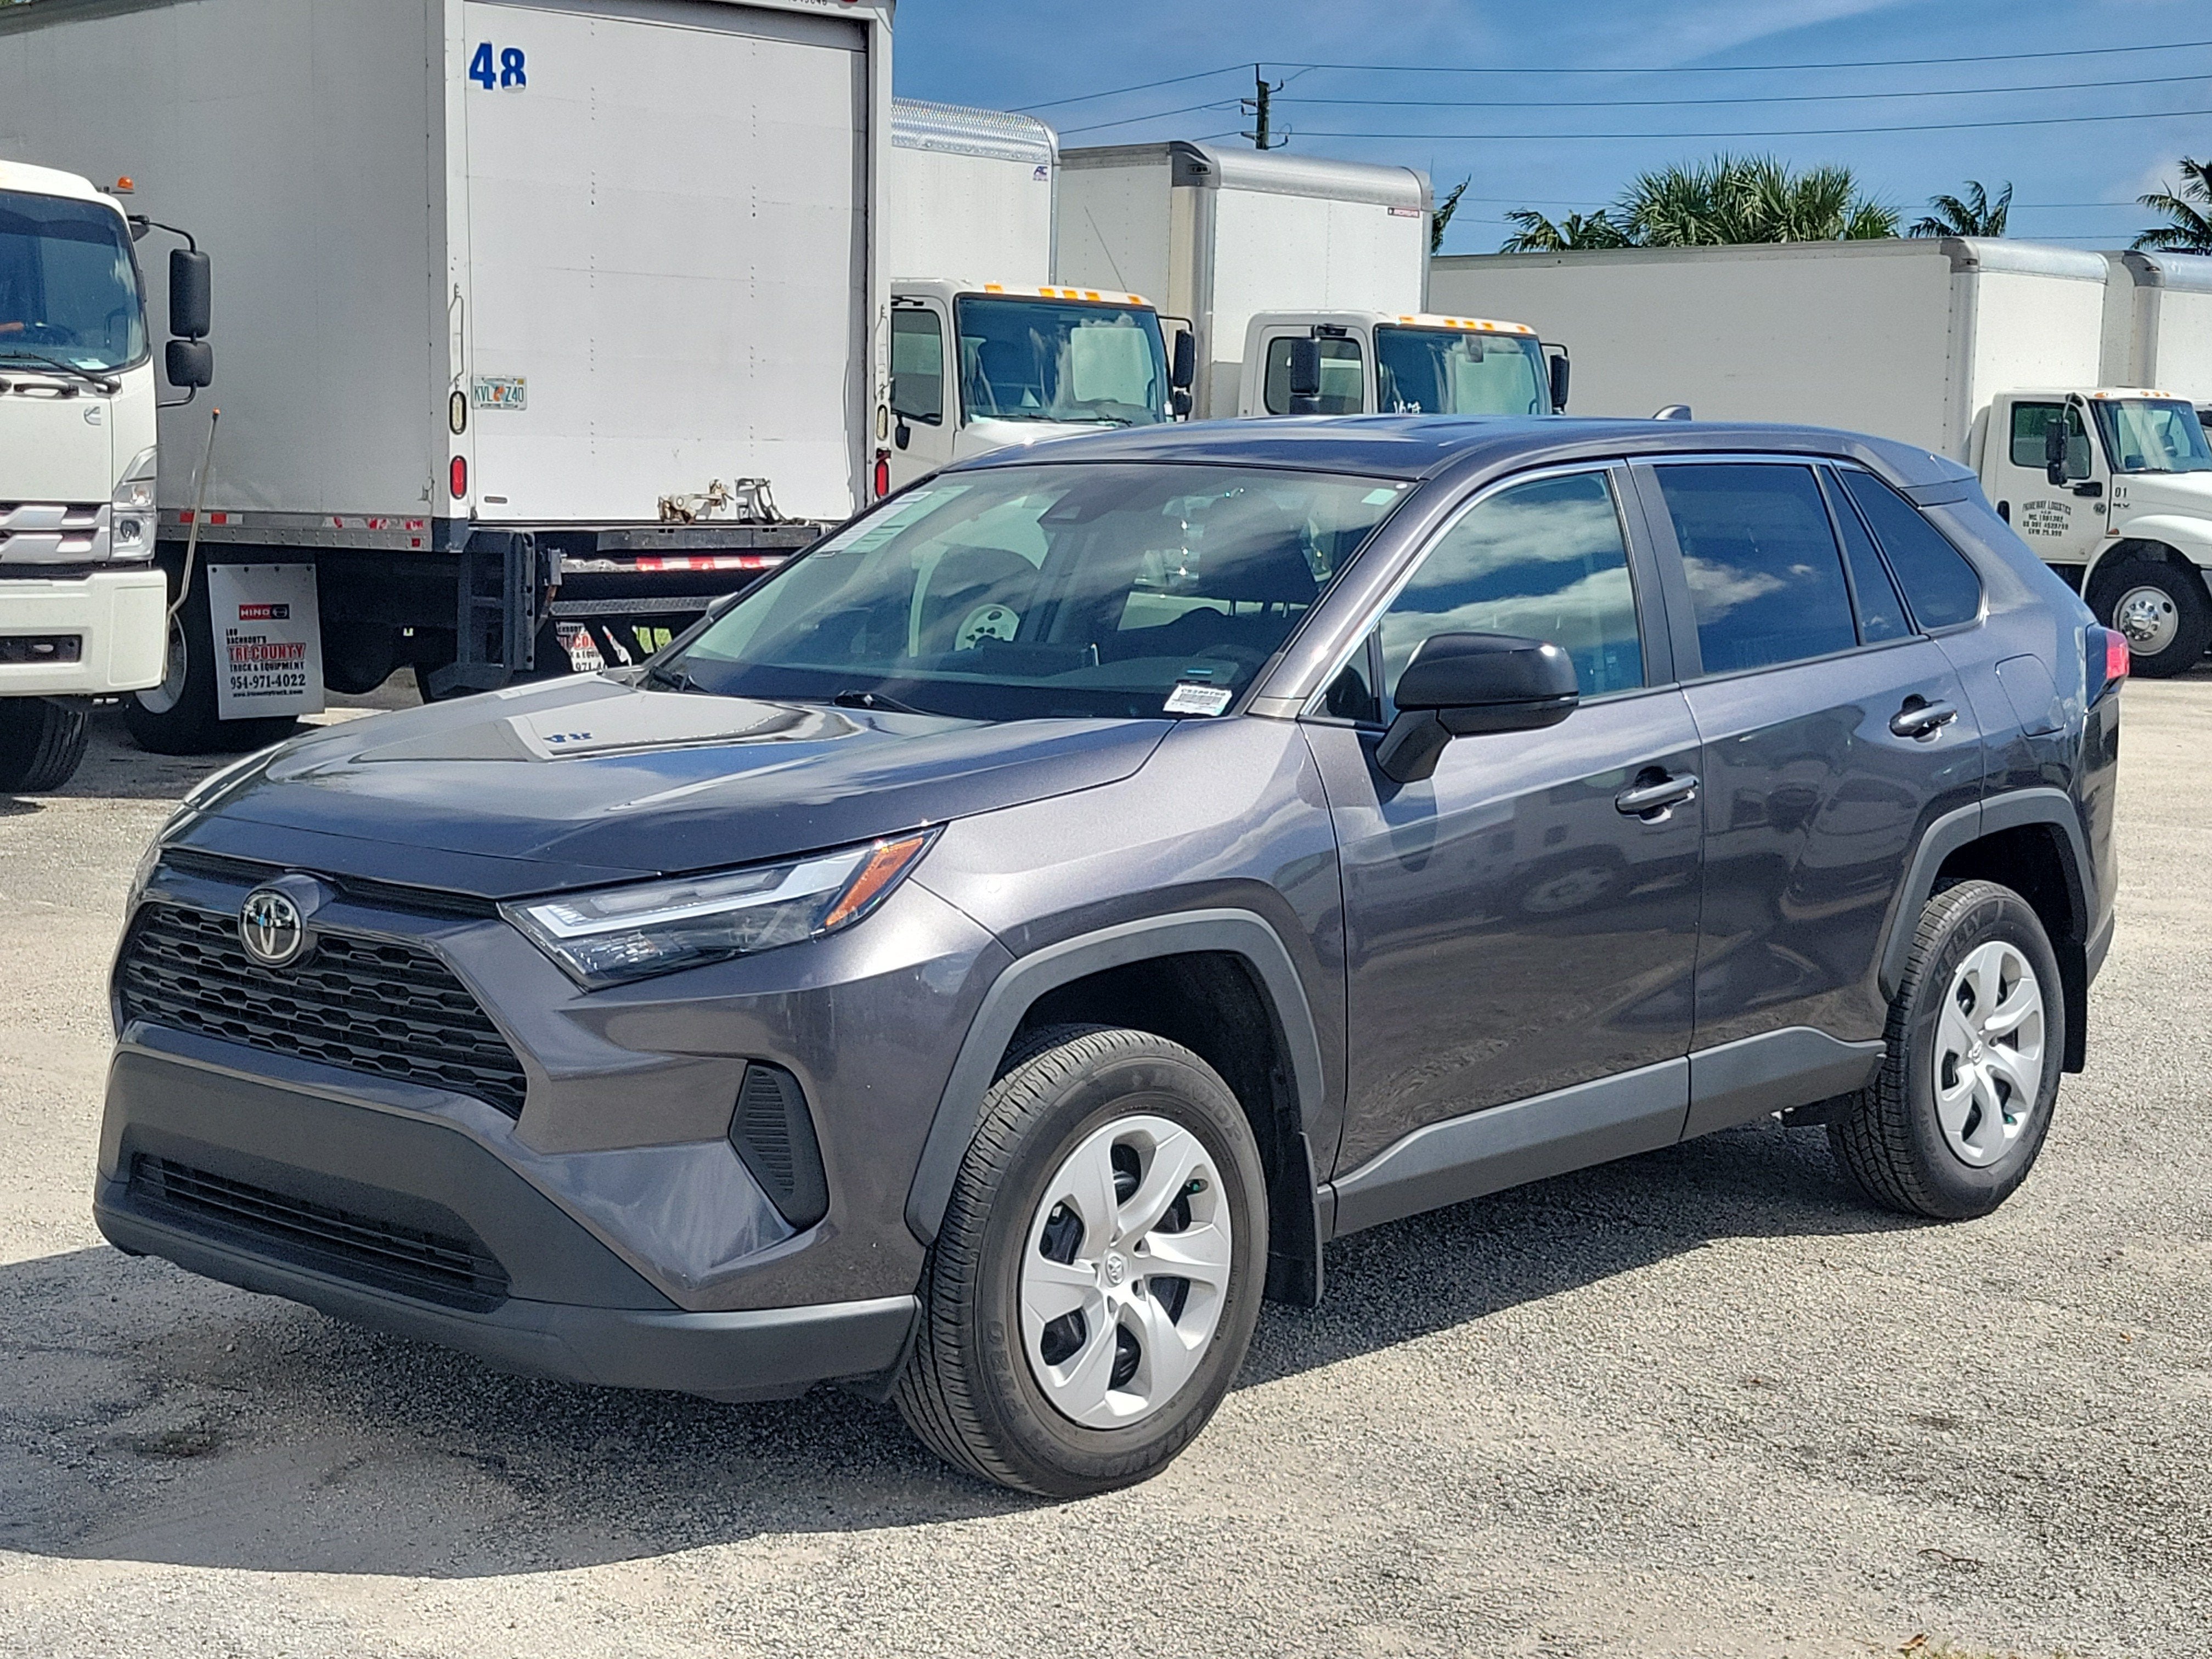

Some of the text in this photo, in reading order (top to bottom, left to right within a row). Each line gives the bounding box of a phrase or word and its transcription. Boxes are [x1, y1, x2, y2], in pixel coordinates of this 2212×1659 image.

[469, 42, 526, 93] 48
[475, 385, 524, 402] KVL Z40
[2115, 487, 2127, 498] 01
[240, 608, 270, 617] HINO
[228, 644, 305, 661] TRI-COUNTY
[230, 663, 252, 673] TRUCK
[261, 662, 304, 672] EQUIPMENT
[230, 674, 306, 690] 954-971-4022
